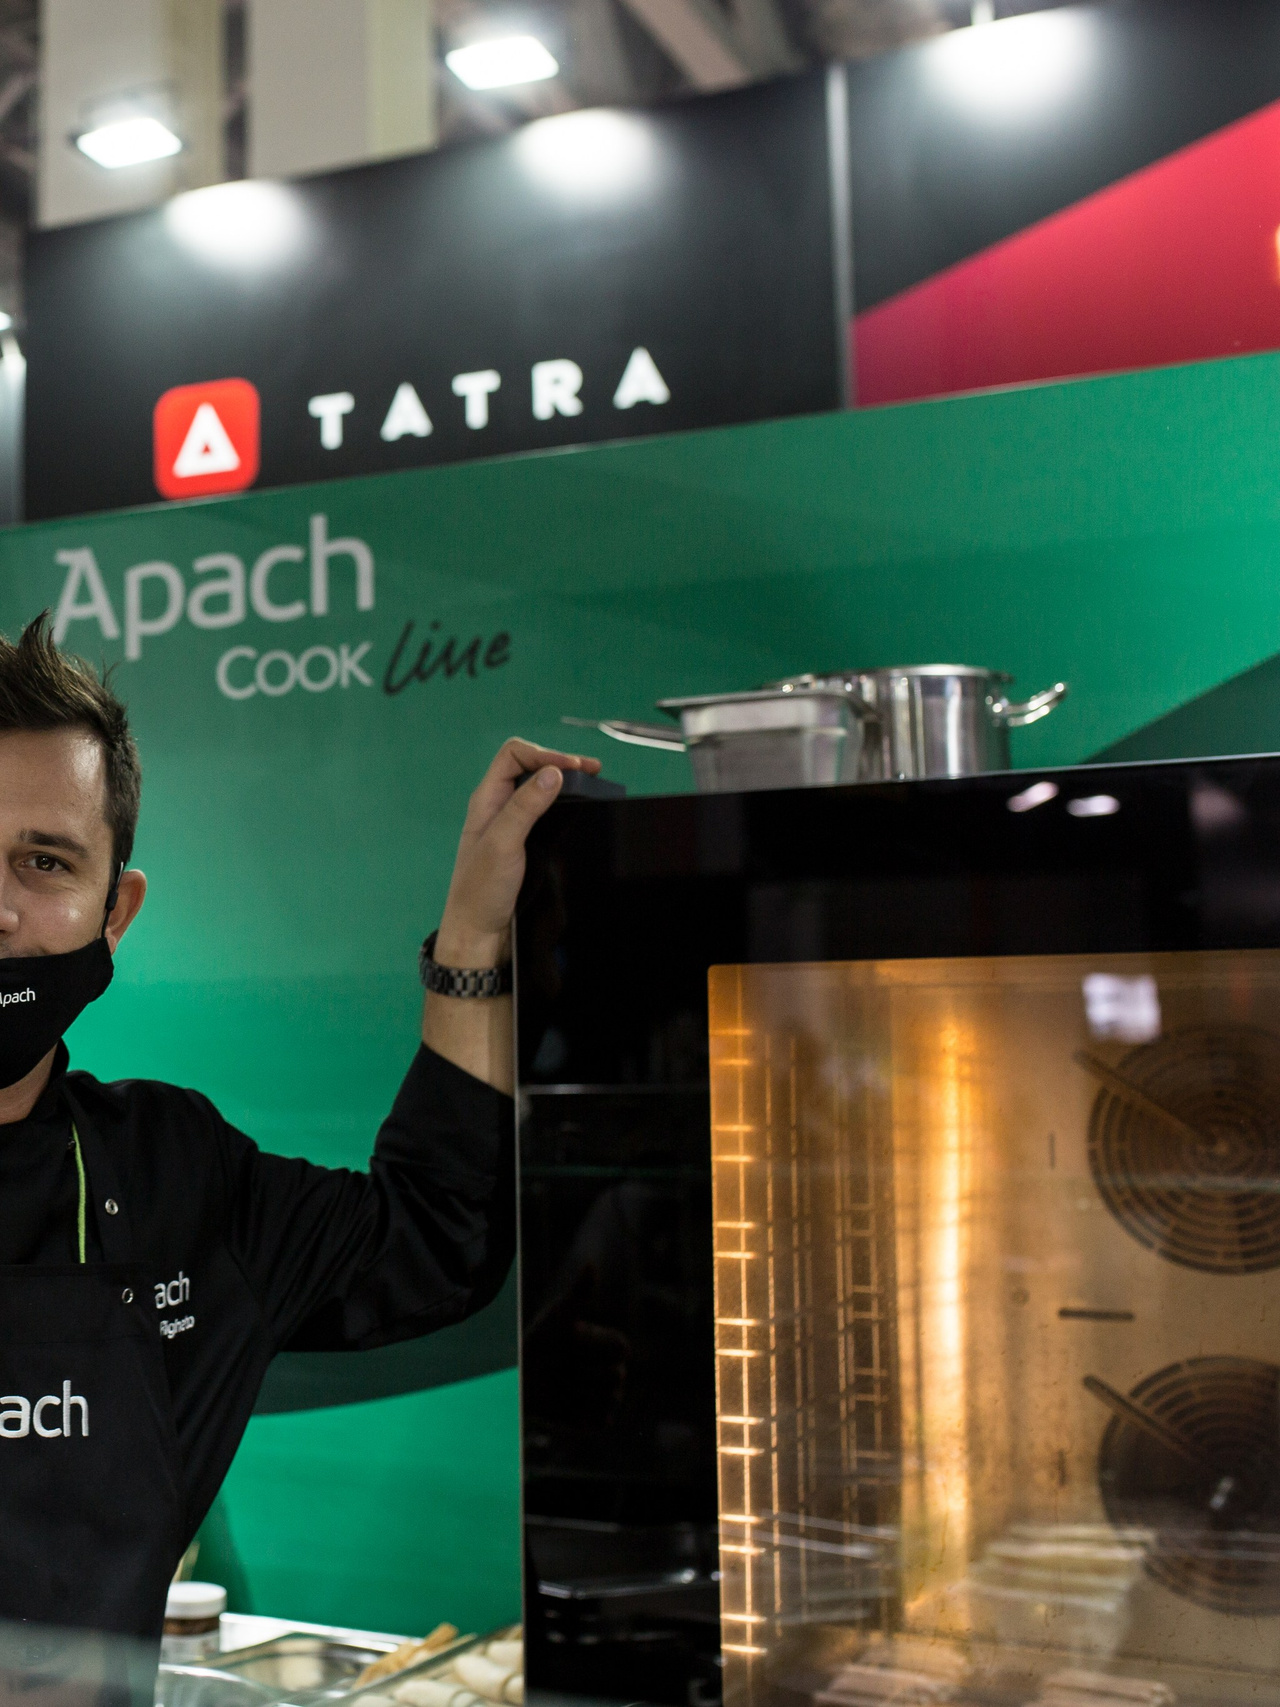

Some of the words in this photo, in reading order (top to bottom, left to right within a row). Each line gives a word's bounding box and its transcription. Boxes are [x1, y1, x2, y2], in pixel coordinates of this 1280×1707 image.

[308, 346, 670, 450] TATRA
[53, 513, 375, 662] Apach
[216, 641, 374, 699] COOK
[154, 1271, 190, 1309] ach
